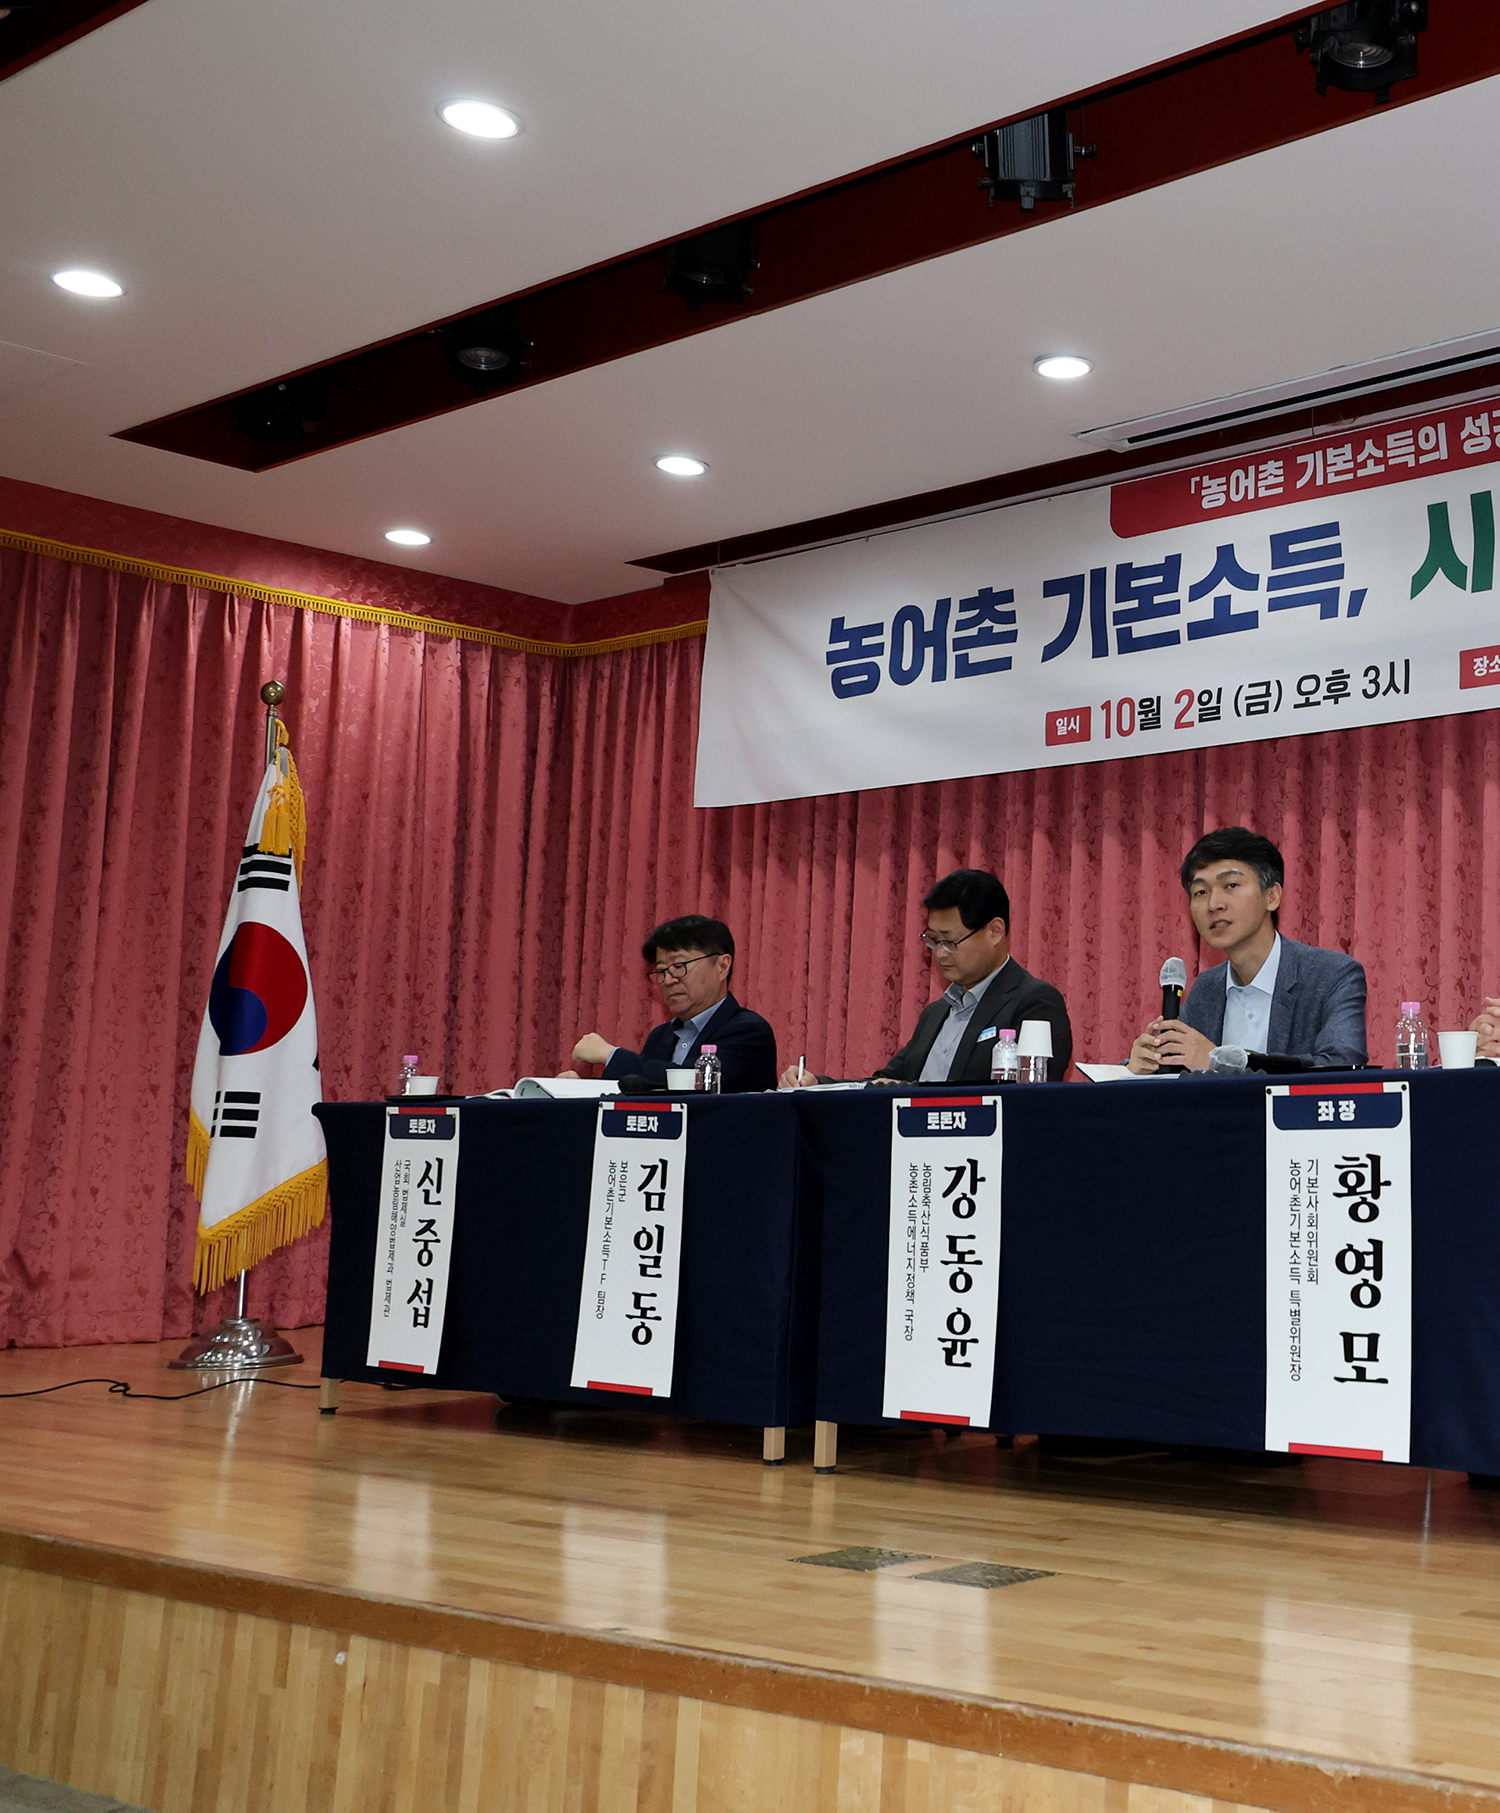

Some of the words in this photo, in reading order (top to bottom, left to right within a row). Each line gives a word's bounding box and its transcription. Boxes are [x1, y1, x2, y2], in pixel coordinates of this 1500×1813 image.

[1297, 423, 1448, 488] 기본소득의
[826, 588, 1018, 699] 농어촌
[1041, 521, 1367, 663] 기본소득,
[1056, 716, 1079, 735] 일시
[1100, 696, 1161, 739] 10월
[1174, 687, 1222, 729] 2일
[1234, 680, 1282, 717] (금)
[1294, 669, 1350, 709] 오후
[1362, 659, 1409, 699] 3시
[409, 1119, 436, 1133] 토론자
[626, 1116, 658, 1132] 토론자
[927, 1112, 966, 1129] 토론자
[400, 1190, 408, 1227] 법제실
[403, 1160, 410, 1184] 국회
[618, 1161, 628, 1202] 보은군
[407, 1158, 443, 1328] 신중섭
[626, 1158, 668, 1345] 김일동
[906, 1163, 918, 1304] 농촌소득에너지정책
[920, 1163, 932, 1272] 농림축산식품부
[1290, 1159, 1301, 1284] 농어촌기본소득
[1307, 1159, 1319, 1284] 기본사회위원회
[596, 1291, 605, 1319] 팀장
[938, 1158, 986, 1367] 강동윤
[1333, 1154, 1391, 1384] 황영모
[904, 1310, 913, 1341] 국장
[1290, 1290, 1301, 1381] 특별위원장
